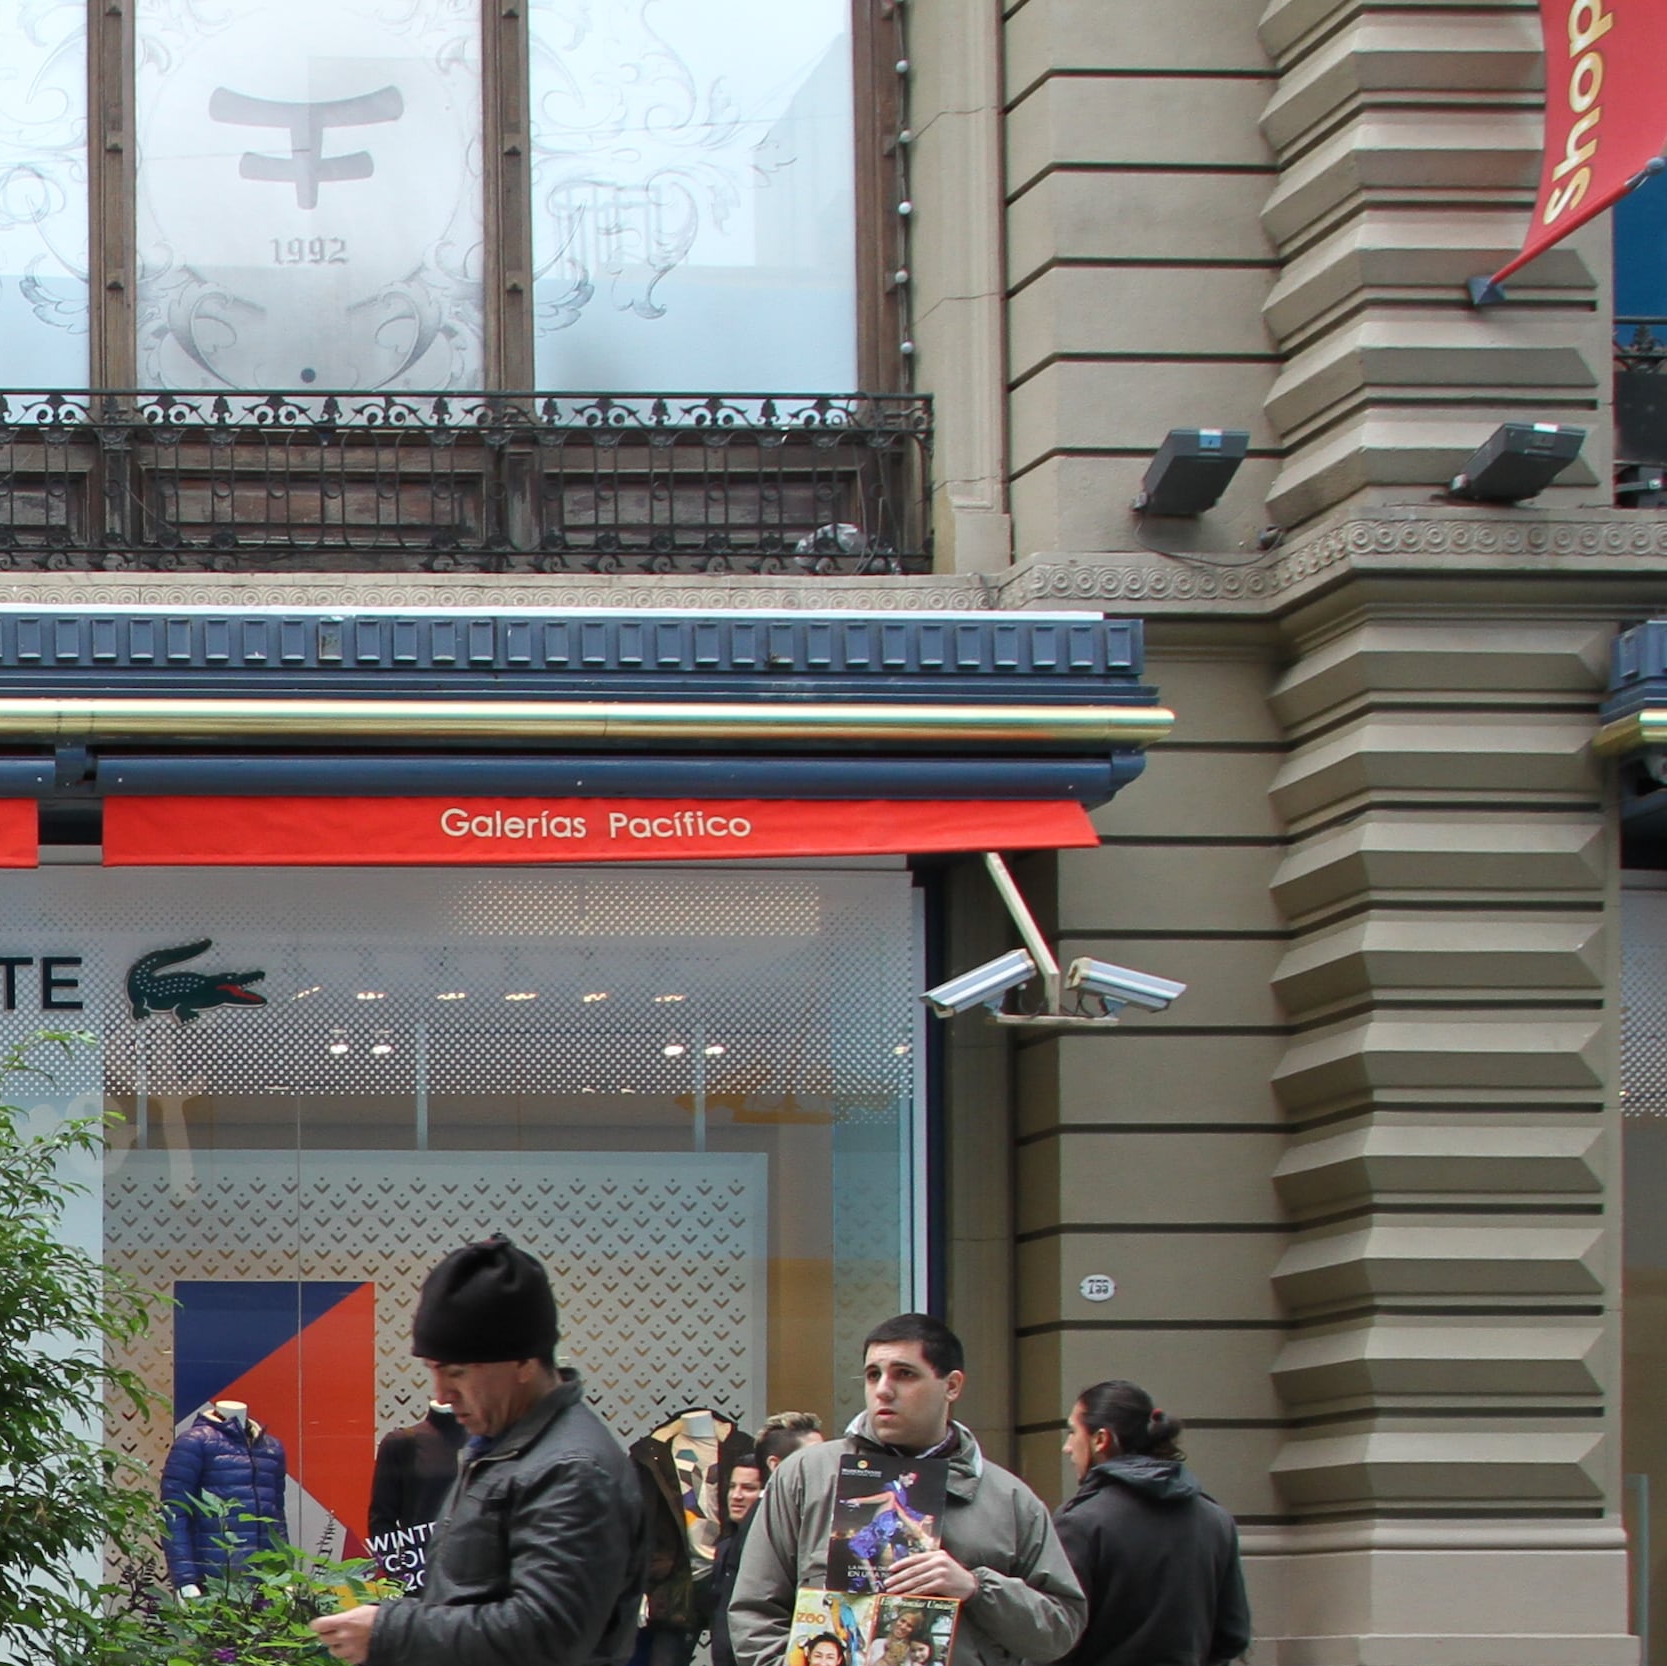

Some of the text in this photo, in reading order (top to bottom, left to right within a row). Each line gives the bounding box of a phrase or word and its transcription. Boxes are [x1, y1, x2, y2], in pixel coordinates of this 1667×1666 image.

[269, 236, 349, 265] 1992
[440, 807, 752, 838] Galerías Pacífico
